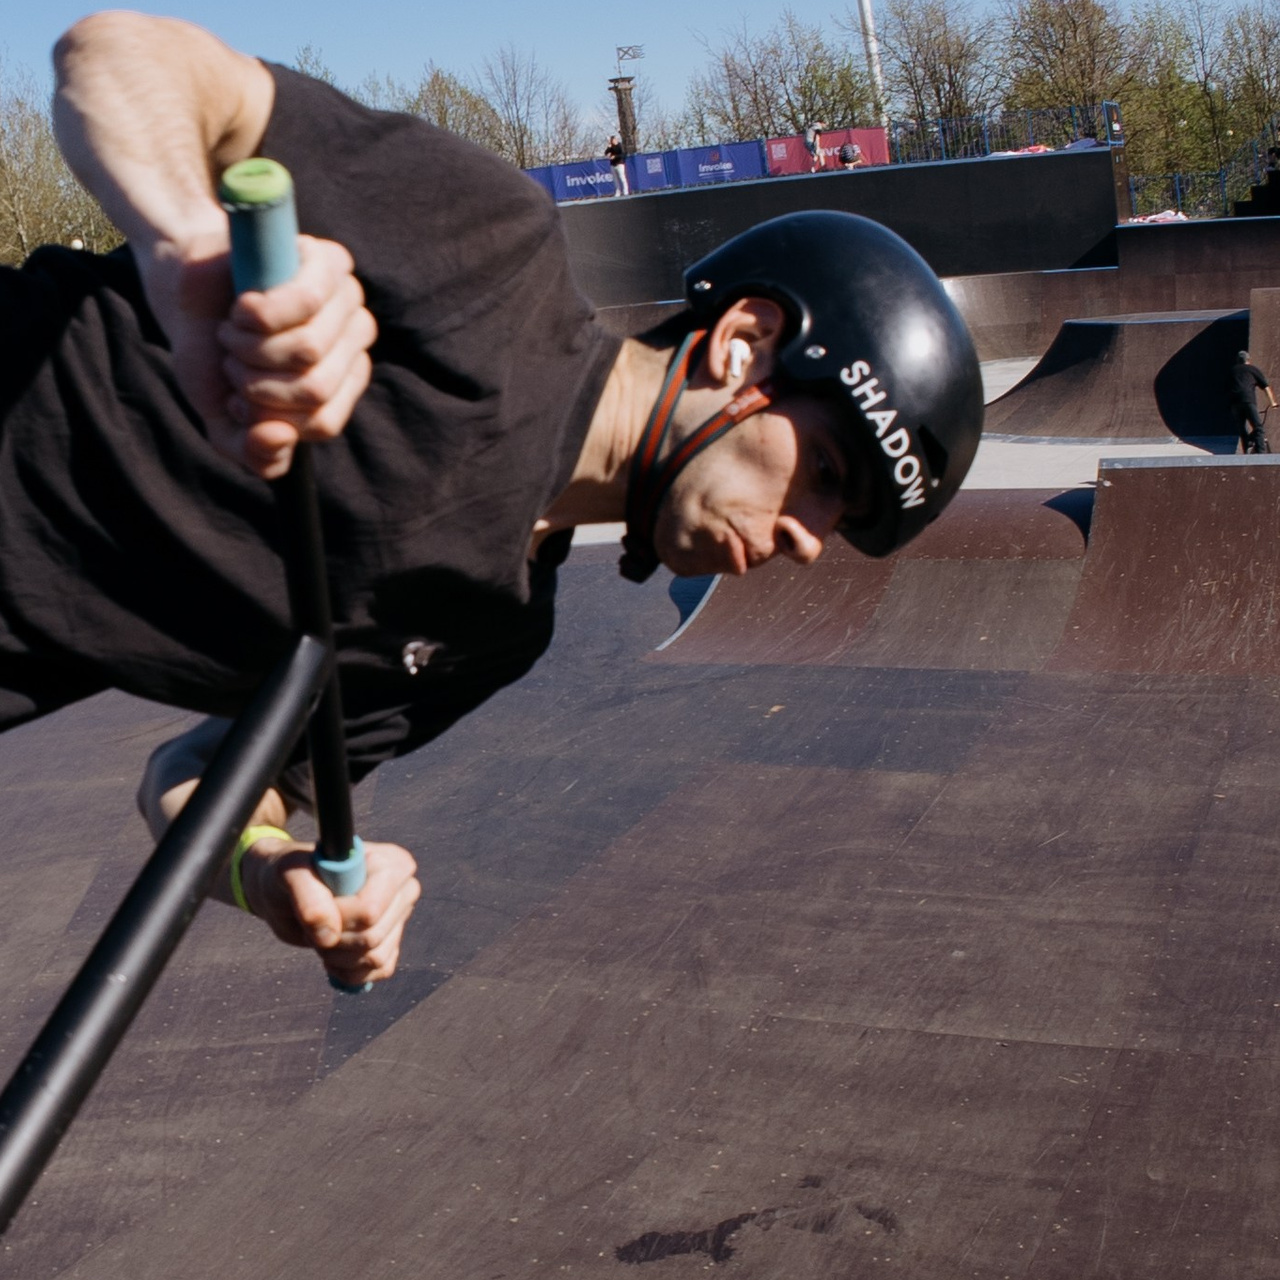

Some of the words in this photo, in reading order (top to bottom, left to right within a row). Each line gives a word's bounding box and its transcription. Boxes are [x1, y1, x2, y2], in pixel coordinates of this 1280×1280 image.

[699, 162, 733, 172] invoke
[566, 172, 614, 187] invoke
[840, 360, 925, 510] SHADOW
